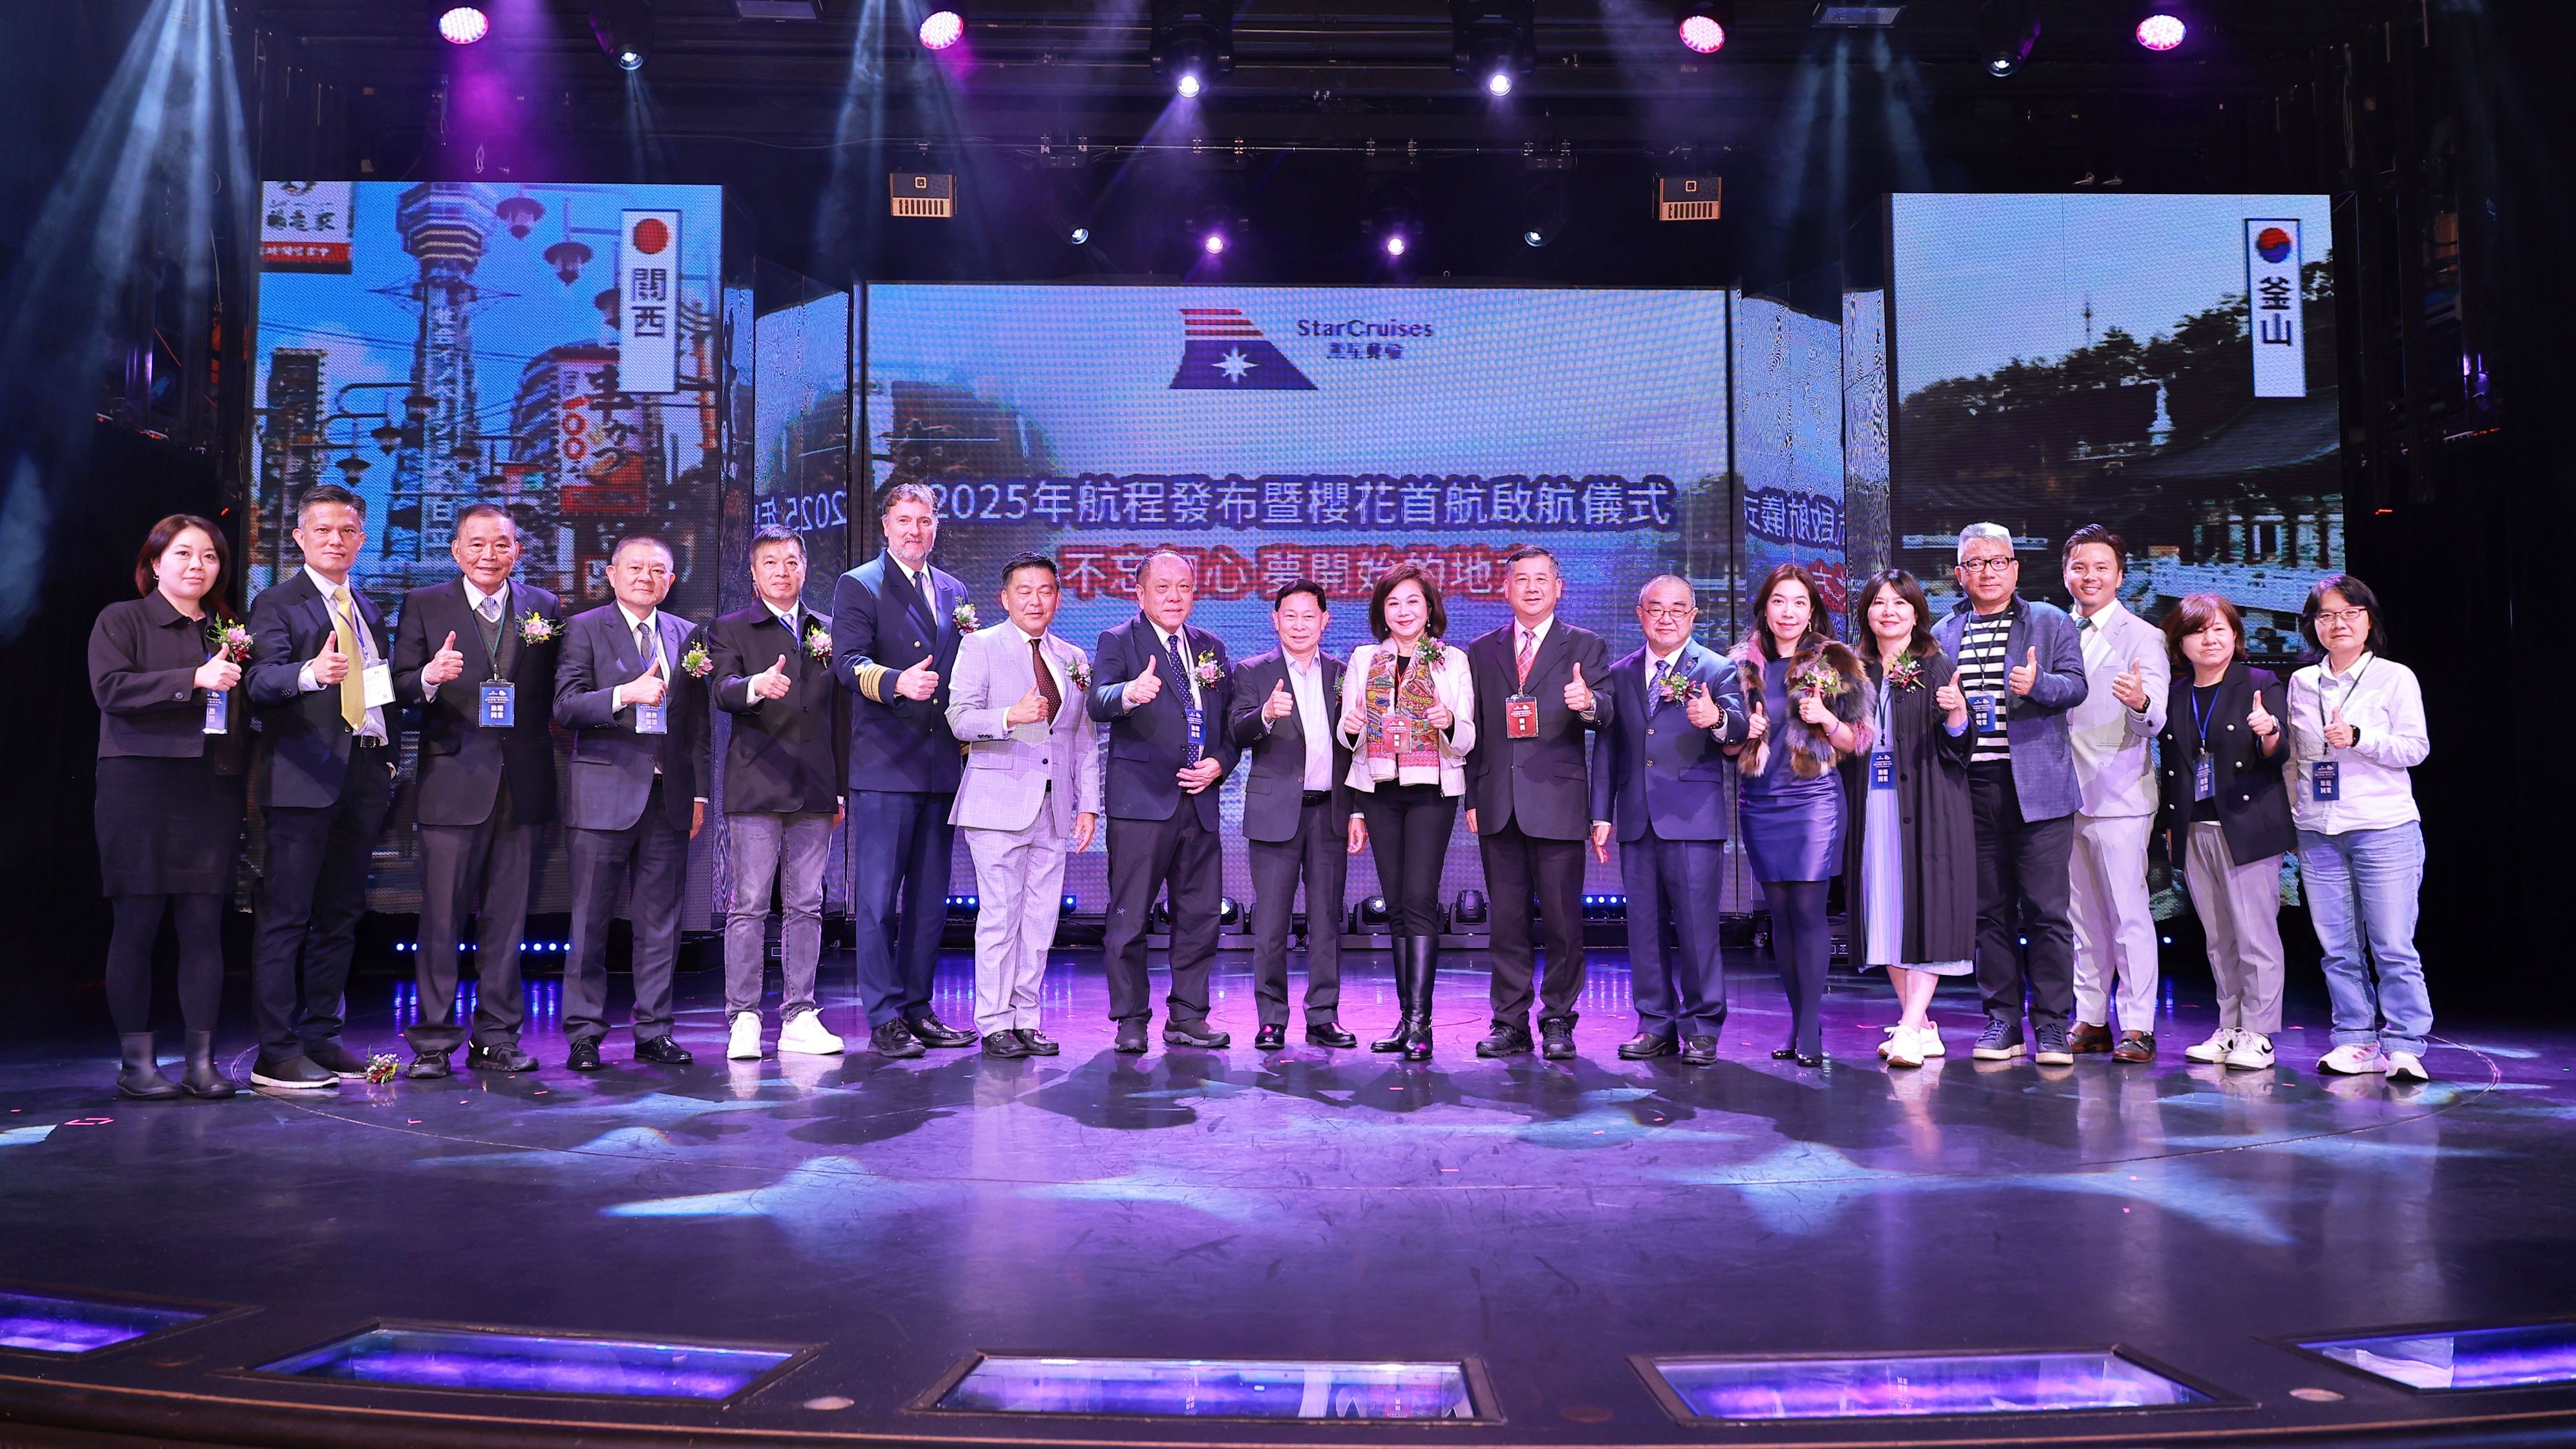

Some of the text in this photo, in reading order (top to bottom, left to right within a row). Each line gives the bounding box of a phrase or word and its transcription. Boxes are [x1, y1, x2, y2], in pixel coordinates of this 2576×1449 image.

[1297, 318, 1434, 337] StarCruises
[2259, 276, 2291, 346] 釜山
[1064, 551, 1247, 594] 不忘心
